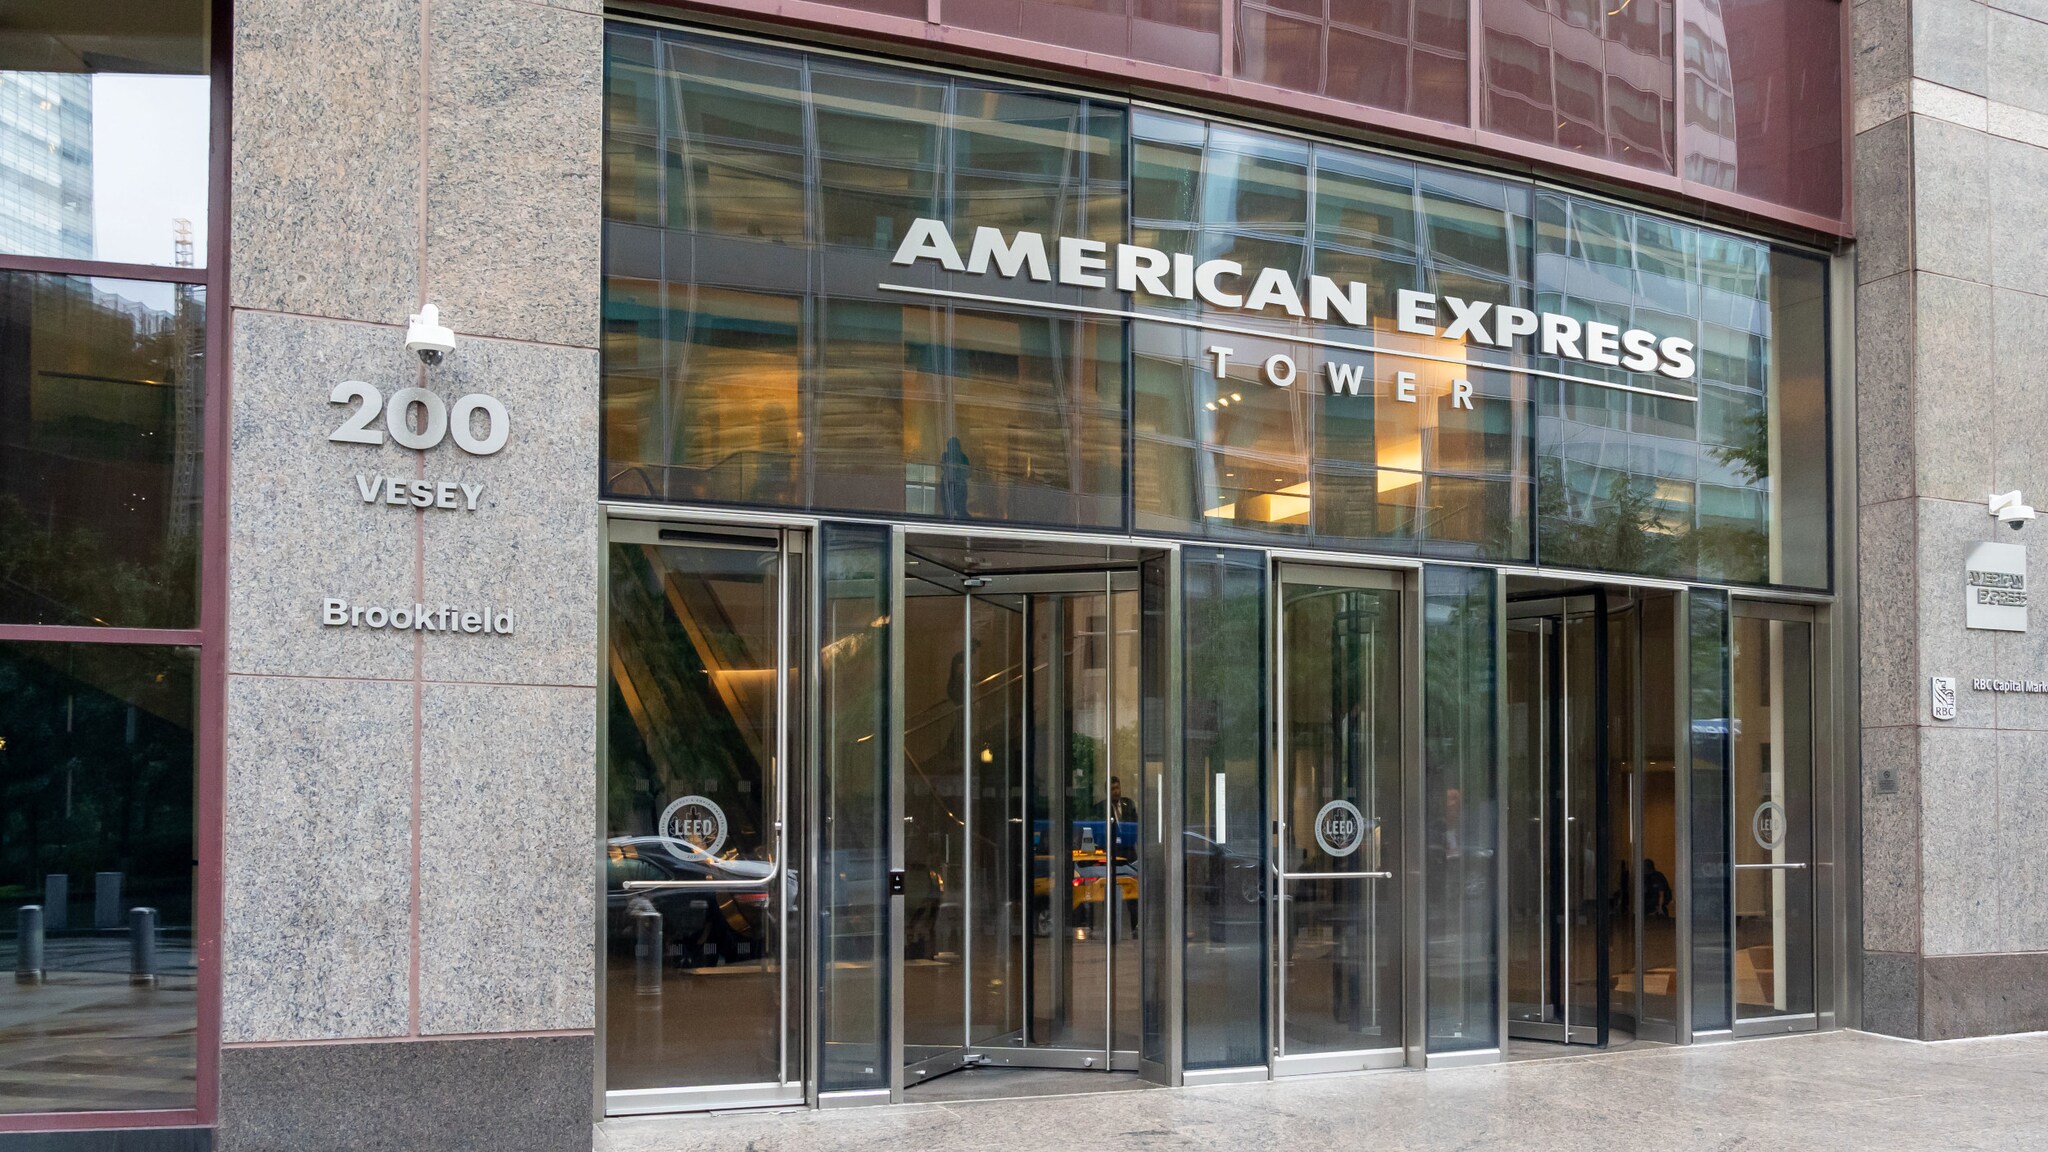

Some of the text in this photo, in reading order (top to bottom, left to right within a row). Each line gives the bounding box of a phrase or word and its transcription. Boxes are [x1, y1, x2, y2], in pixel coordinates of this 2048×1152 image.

[892, 218, 1696, 380] AMERICAN EXPRESS
[1210, 345, 1474, 410] TOWER
[329, 380, 511, 456] 200
[355, 474, 484, 511] VESEY
[322, 597, 515, 635] Brookfield
[1973, 678, 2048, 694] RBC Capital Mark
[1935, 706, 1954, 716] RBC
[674, 819, 712, 835] LEED
[1326, 820, 1353, 835] LEED
